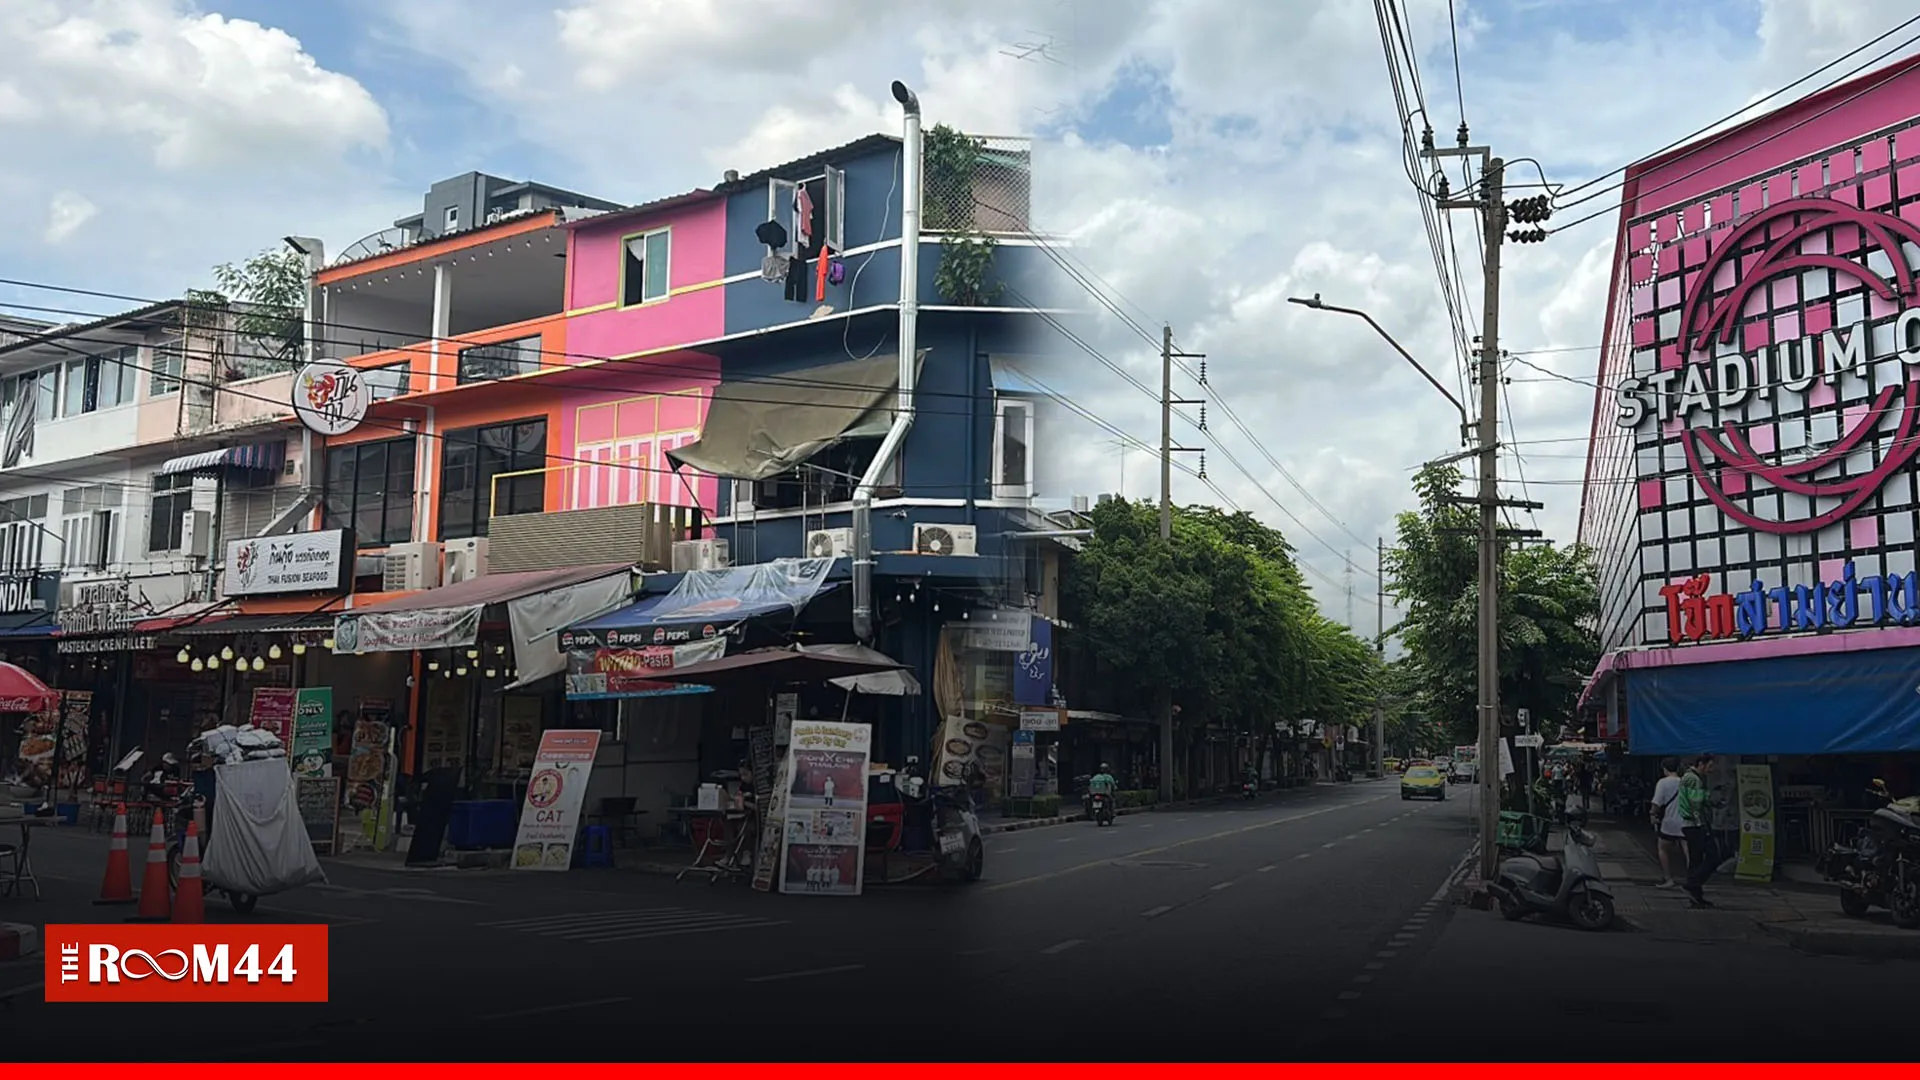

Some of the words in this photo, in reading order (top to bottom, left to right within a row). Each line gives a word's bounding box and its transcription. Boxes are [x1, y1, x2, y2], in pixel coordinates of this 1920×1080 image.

[1616, 322, 1868, 428] STADIUM
[268, 575, 280, 584] THAI
[281, 573, 300, 583] FUSION
[302, 571, 328, 582] SEAFOOD
[575, 635, 596, 645] PEPSI
[619, 633, 642, 643] PEPSI
[666, 630, 690, 640] PEPSI
[298, 706, 325, 715] ONLY
[536, 810, 565, 822] CAT
